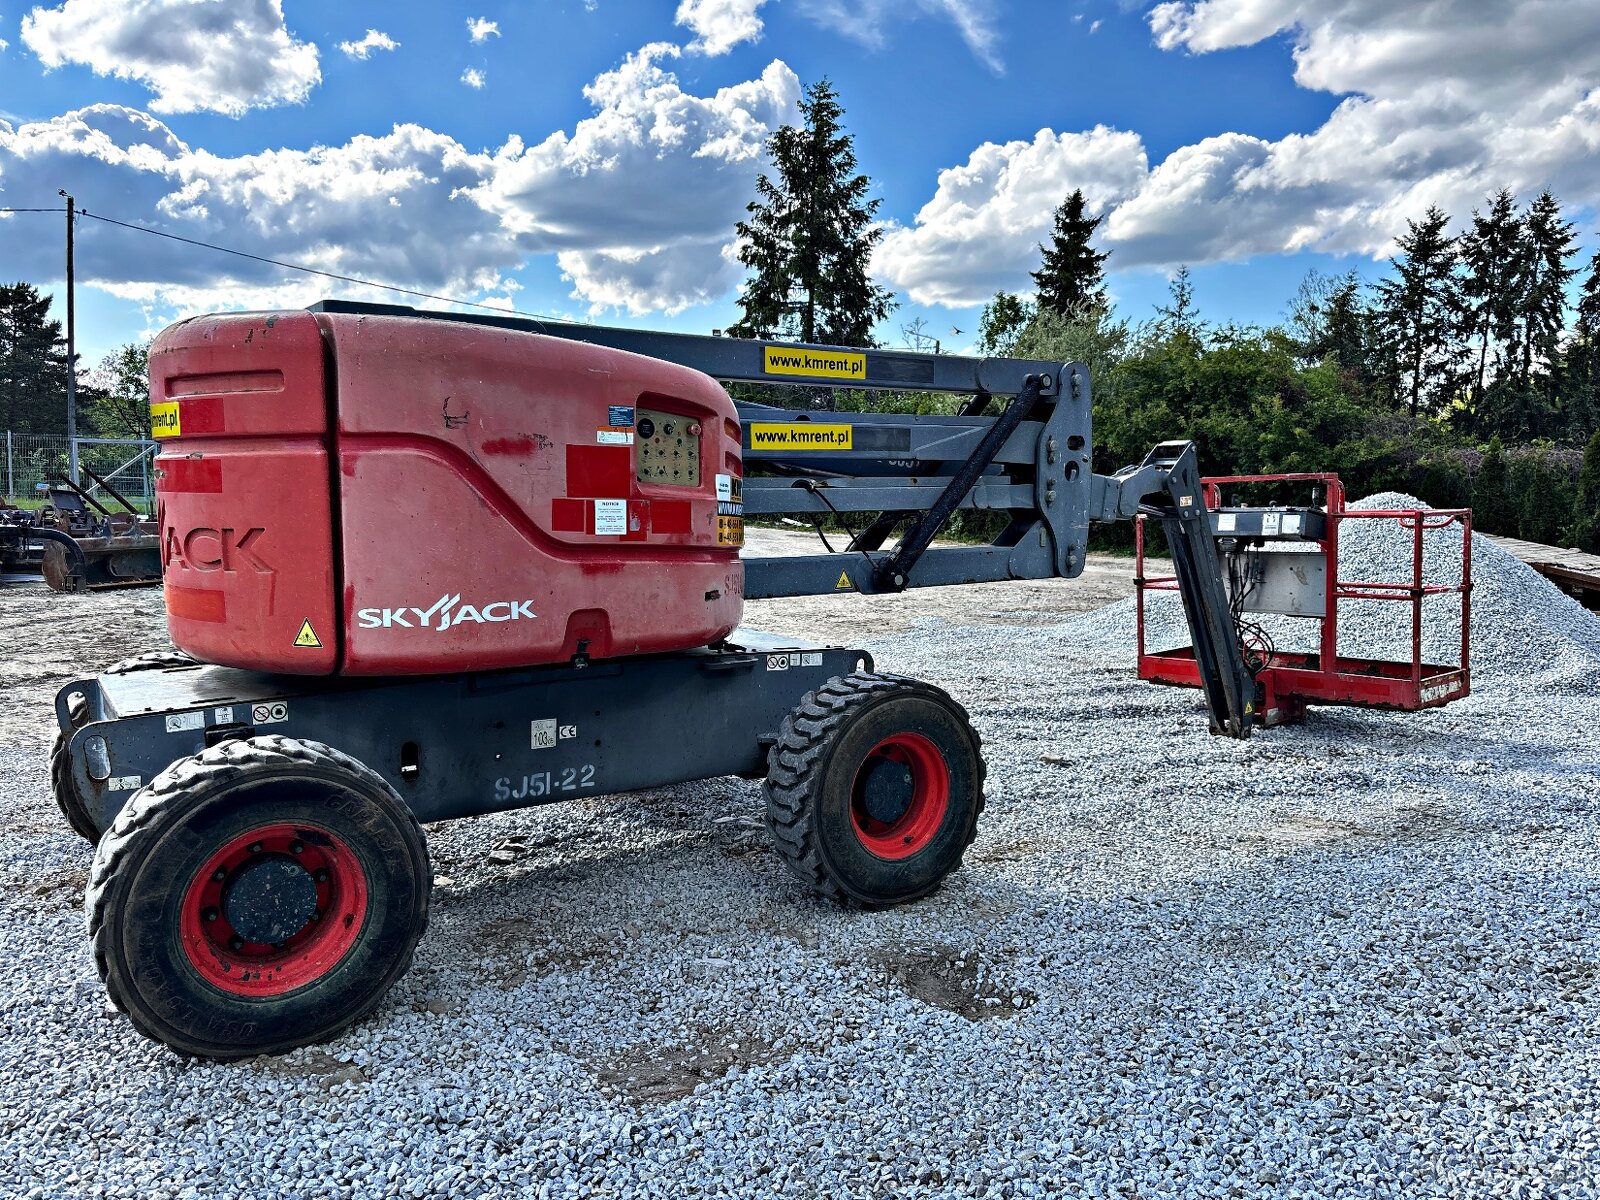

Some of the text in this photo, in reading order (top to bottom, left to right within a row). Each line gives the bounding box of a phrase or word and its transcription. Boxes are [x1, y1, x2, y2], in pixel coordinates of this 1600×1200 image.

[769, 355, 863, 375] www.kmrent.pl
[755, 429, 849, 446] www.kmrent.pl
[357, 592, 538, 632] SKYJACK
[560, 726, 576, 738] CE
[494, 764, 596, 800] SJ51-22
